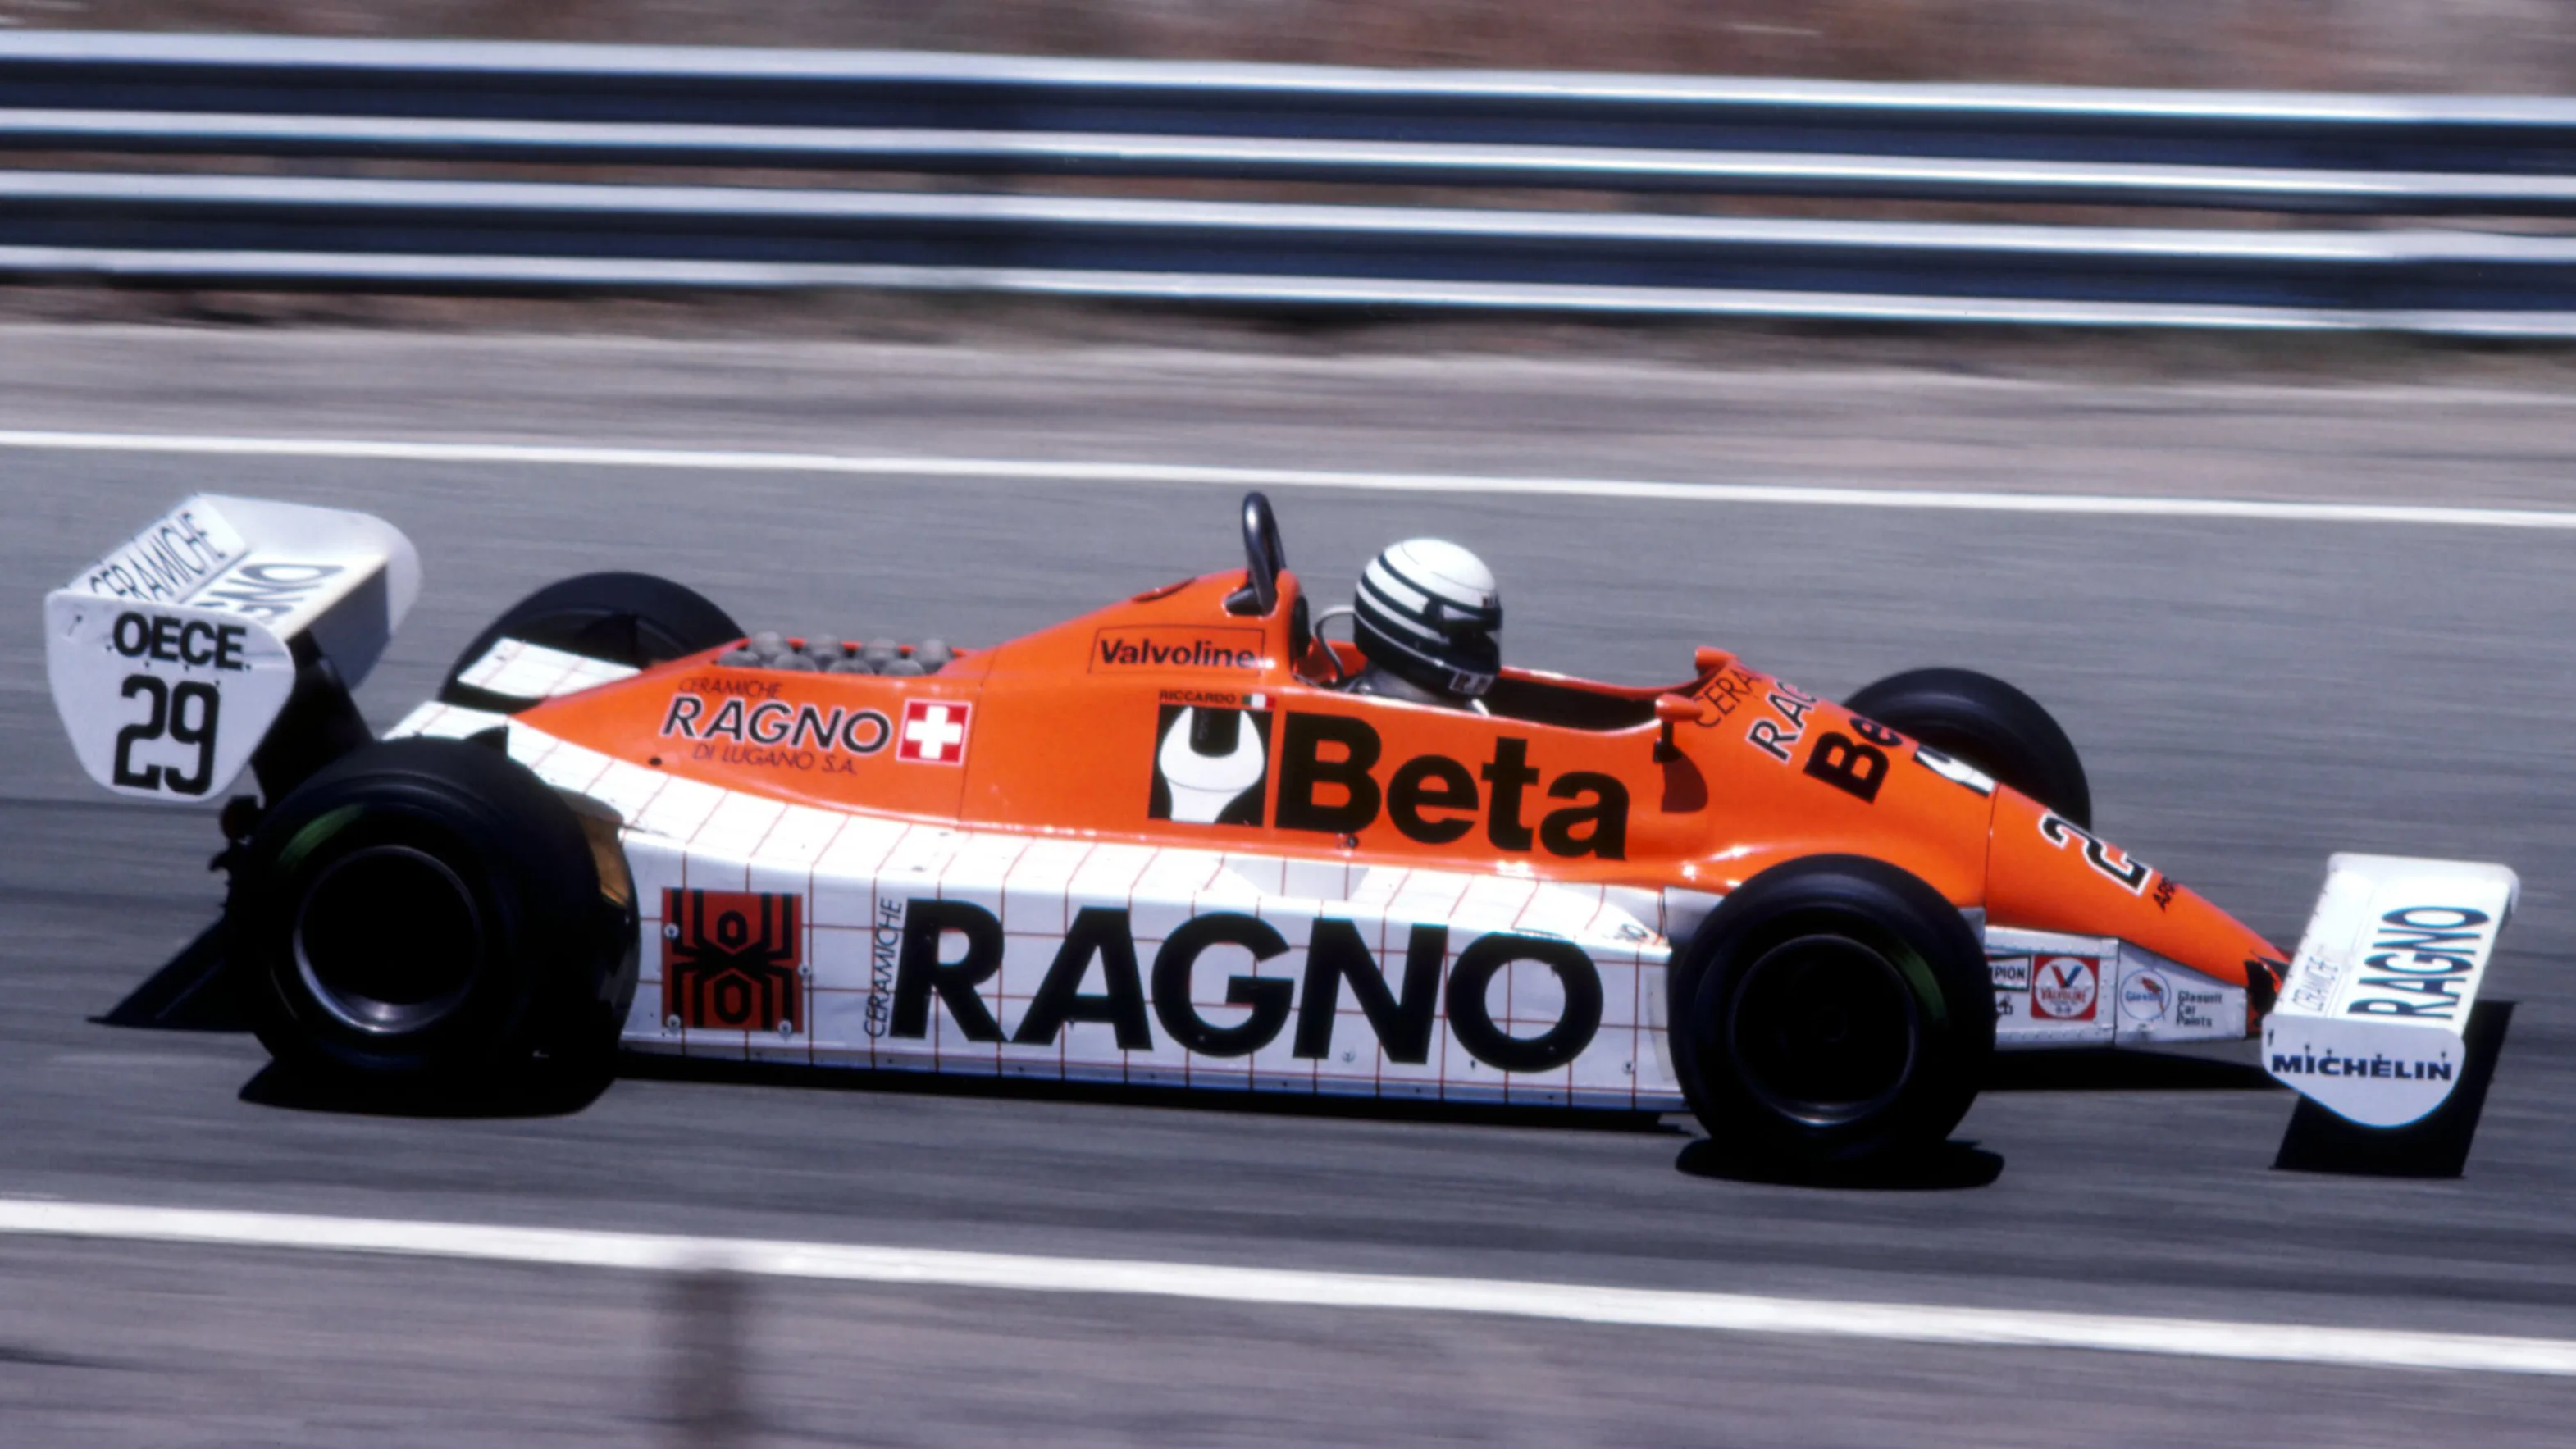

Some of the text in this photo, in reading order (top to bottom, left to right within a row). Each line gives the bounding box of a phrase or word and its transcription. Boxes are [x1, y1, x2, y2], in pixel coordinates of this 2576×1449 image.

[113, 611, 247, 671] OECE
[1100, 637, 1256, 669] Valvoline
[678, 677, 783, 699] CERAMICHE
[1159, 690, 1237, 704] RICCARDO
[113, 673, 220, 796] 29
[661, 695, 892, 754] RAGNO
[692, 743, 715, 761] DI
[722, 745, 815, 771] LUGANO
[1274, 711, 1628, 861] Beta
[2039, 808, 2153, 896] 2
[864, 897, 902, 1038] CERAMICHE
[888, 898, 1603, 1073] RAGNO
[2347, 905, 2490, 1020] RAGNO
[2272, 1055, 2452, 1081] MICHELIN
